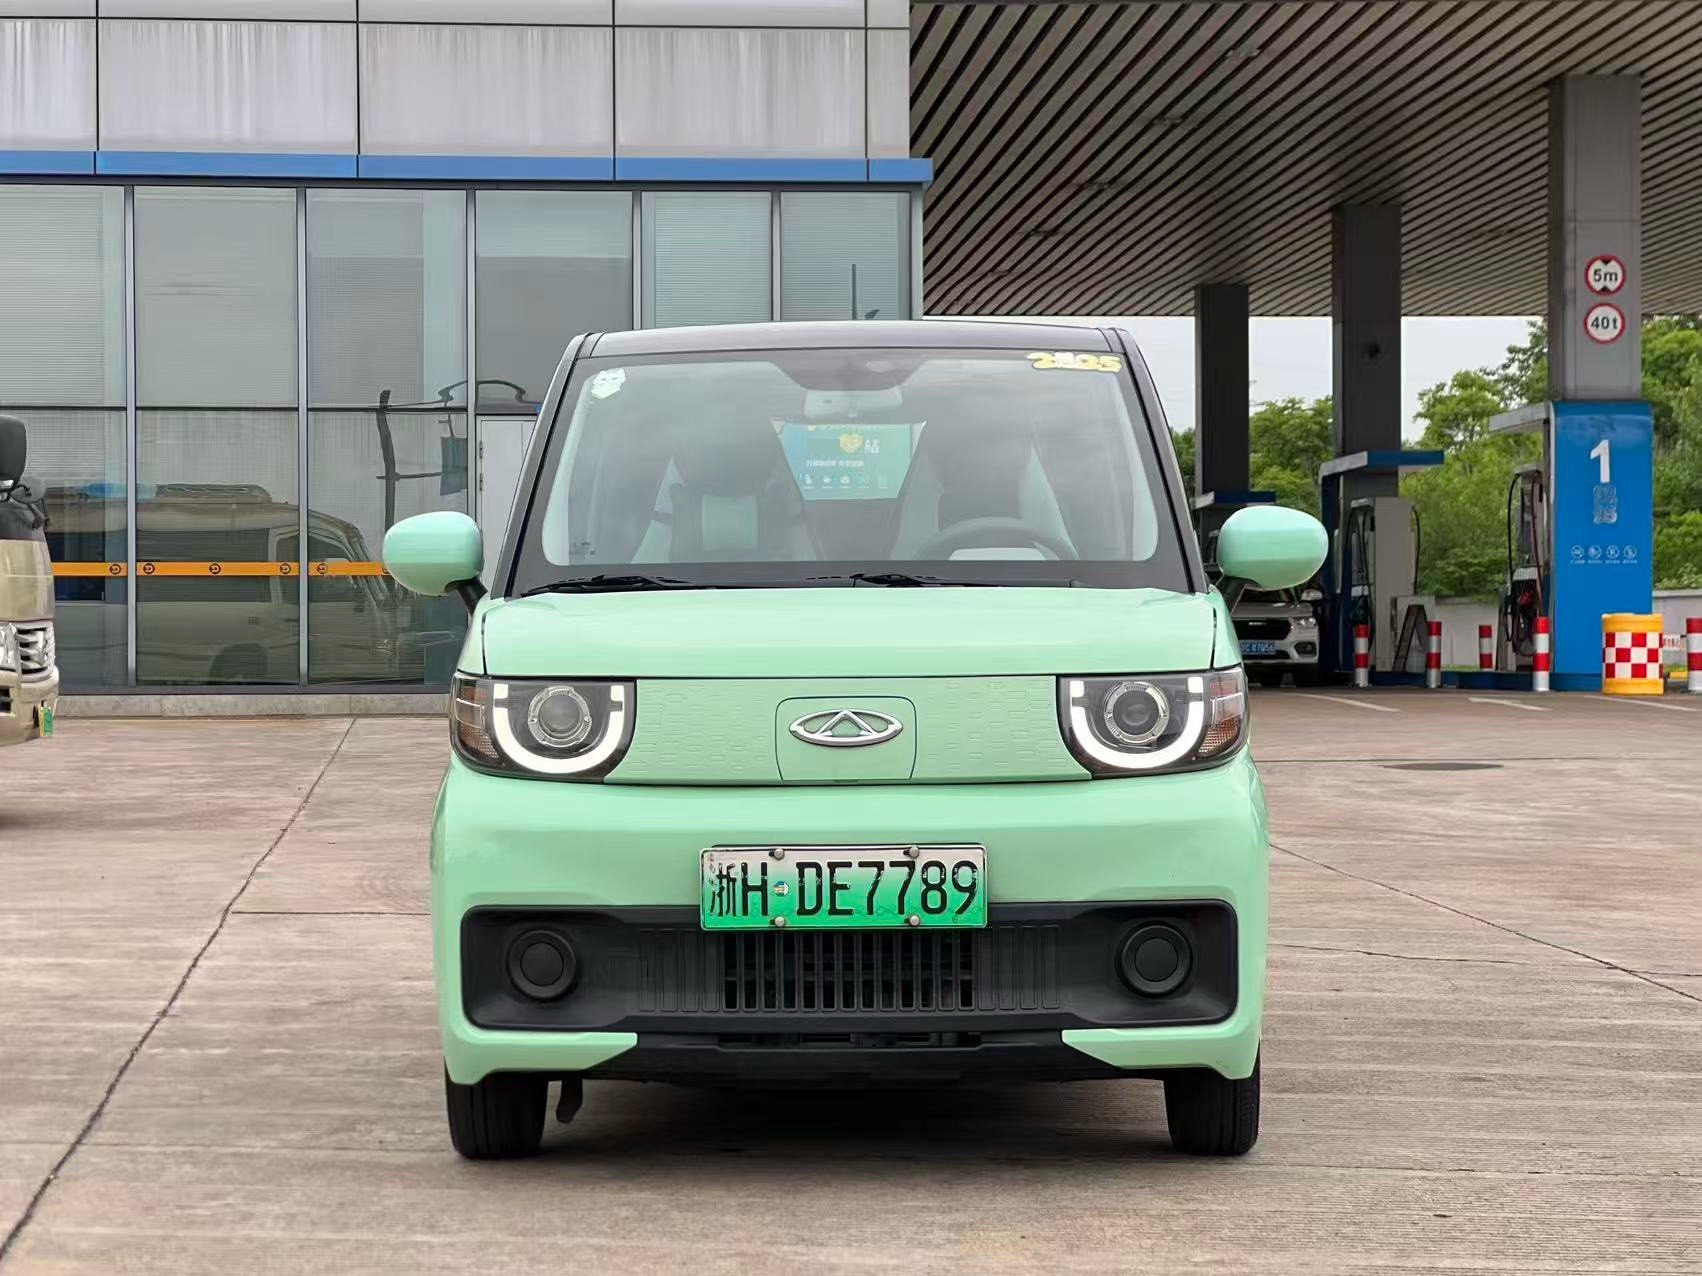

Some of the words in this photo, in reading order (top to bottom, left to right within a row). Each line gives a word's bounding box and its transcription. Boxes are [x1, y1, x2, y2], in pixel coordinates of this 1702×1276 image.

[1593, 269, 1618, 282] 5m
[1591, 316, 1618, 330] 40t
[1590, 439, 1610, 483] 1
[796, 860, 978, 916] DE7789
